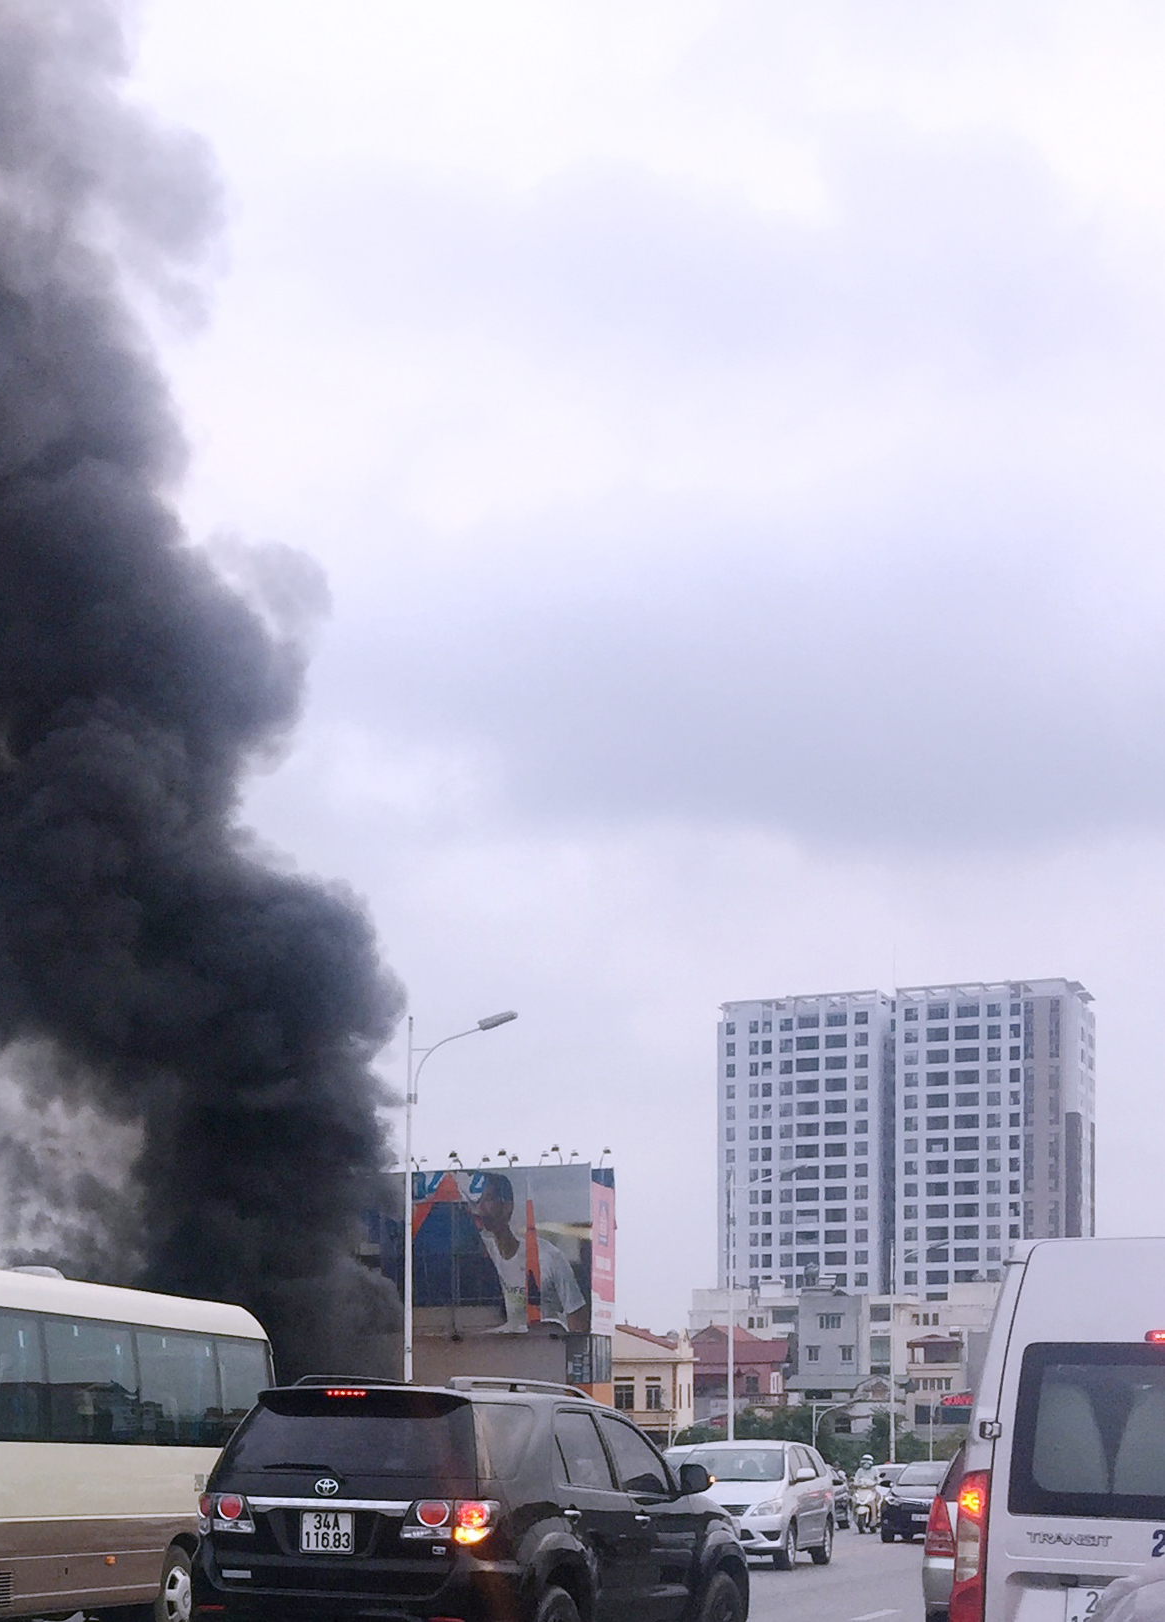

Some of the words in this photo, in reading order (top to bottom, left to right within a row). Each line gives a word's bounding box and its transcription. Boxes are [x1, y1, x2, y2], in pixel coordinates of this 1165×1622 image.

[313, 1513, 341, 1531] 34A
[305, 1531, 351, 1549] 116.83
[1026, 1531, 1113, 1547] TRANSIT
